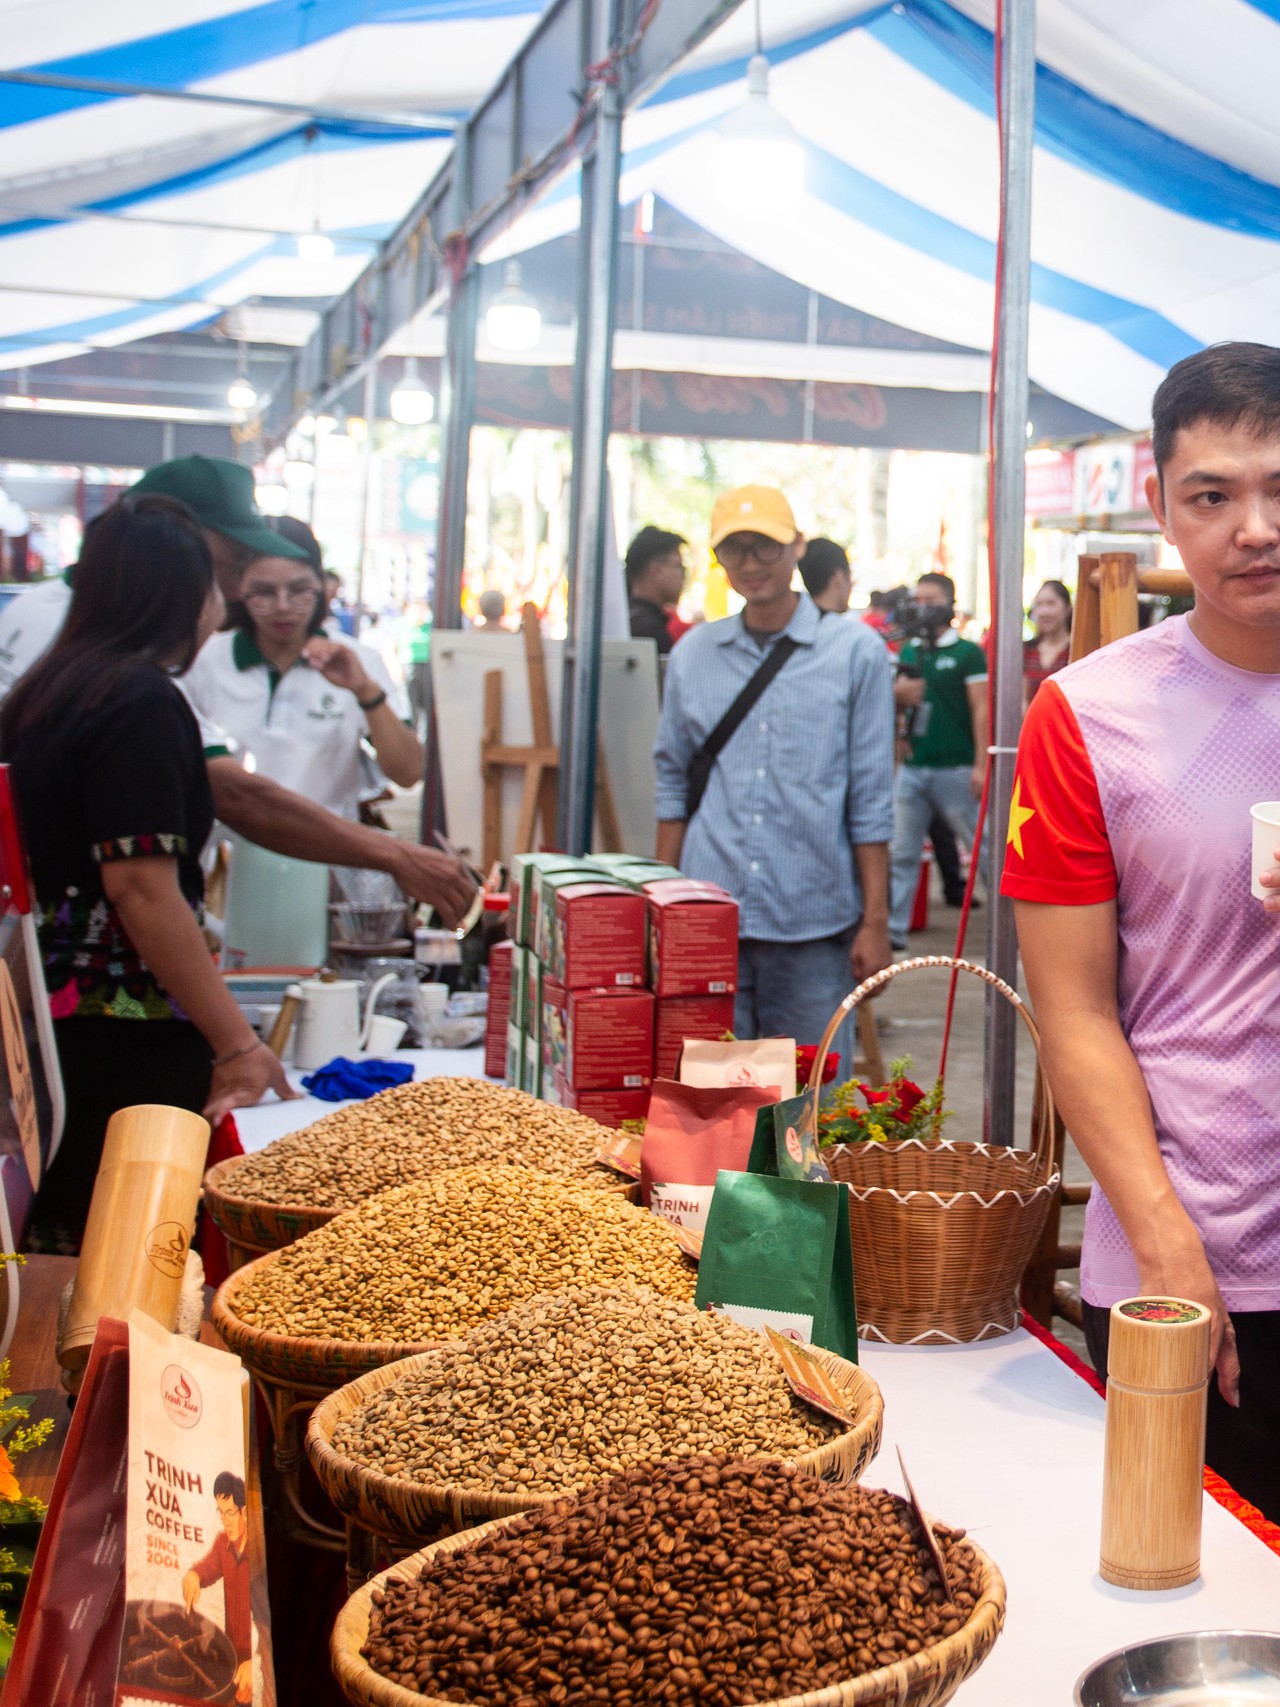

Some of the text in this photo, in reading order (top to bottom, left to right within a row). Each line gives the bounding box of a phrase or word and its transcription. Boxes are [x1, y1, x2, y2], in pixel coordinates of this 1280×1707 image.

[656, 1198, 700, 1213] TRỊNH
[164, 1390, 182, 1406] Trịnh
[144, 1449, 203, 1495] TRỊNH
[145, 1479, 183, 1518] XƯA
[146, 1508, 204, 1544] COFFEE
[146, 1534, 180, 1556] SINCE
[146, 1550, 180, 1570] 2004
